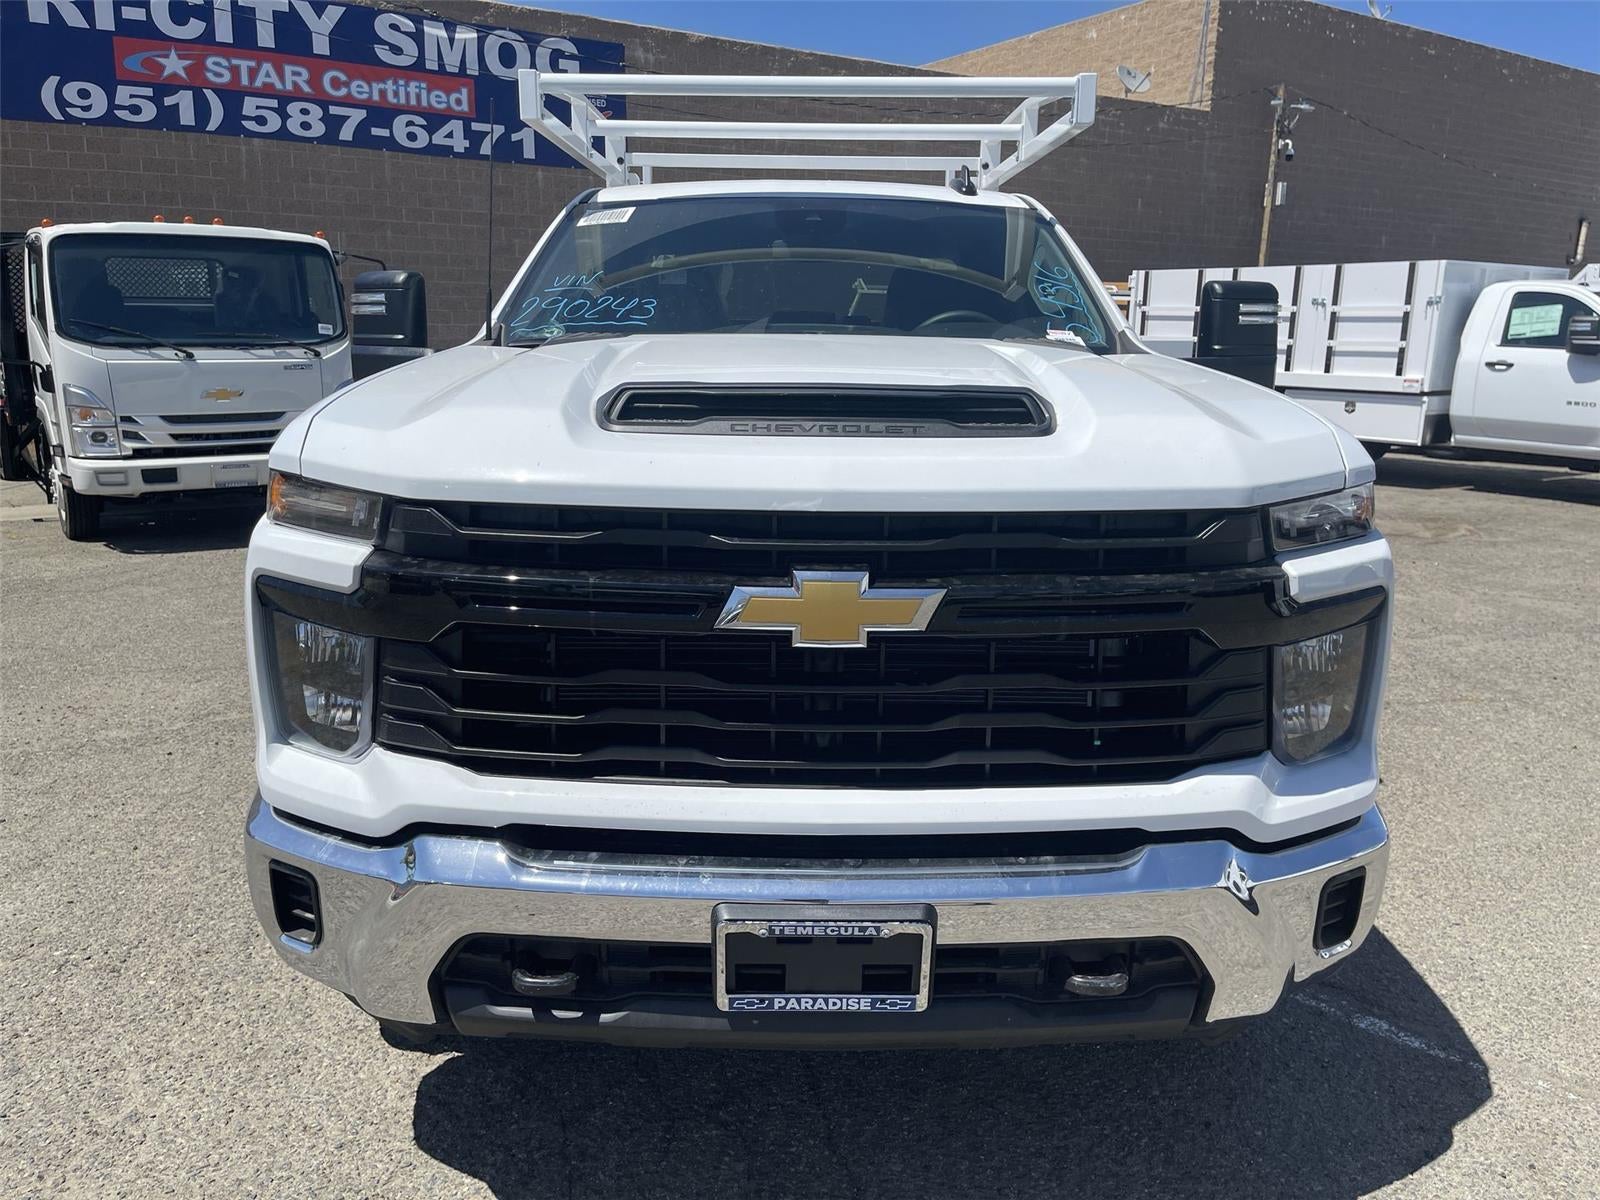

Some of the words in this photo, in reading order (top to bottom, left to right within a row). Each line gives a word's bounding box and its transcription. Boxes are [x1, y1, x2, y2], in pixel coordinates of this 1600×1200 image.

[374, 13, 580, 81] SMOG
[204, 55, 314, 95] STAR
[321, 68, 470, 113] Certified
[41, 75, 225, 132] (951)
[241, 96, 536, 160] 587-6471
[553, 270, 604, 287] VIN
[510, 296, 658, 327] 290243
[730, 423, 926, 434] CHEVROLET
[771, 926, 879, 936] TEMECULA
[773, 997, 872, 1010] PARADISE
